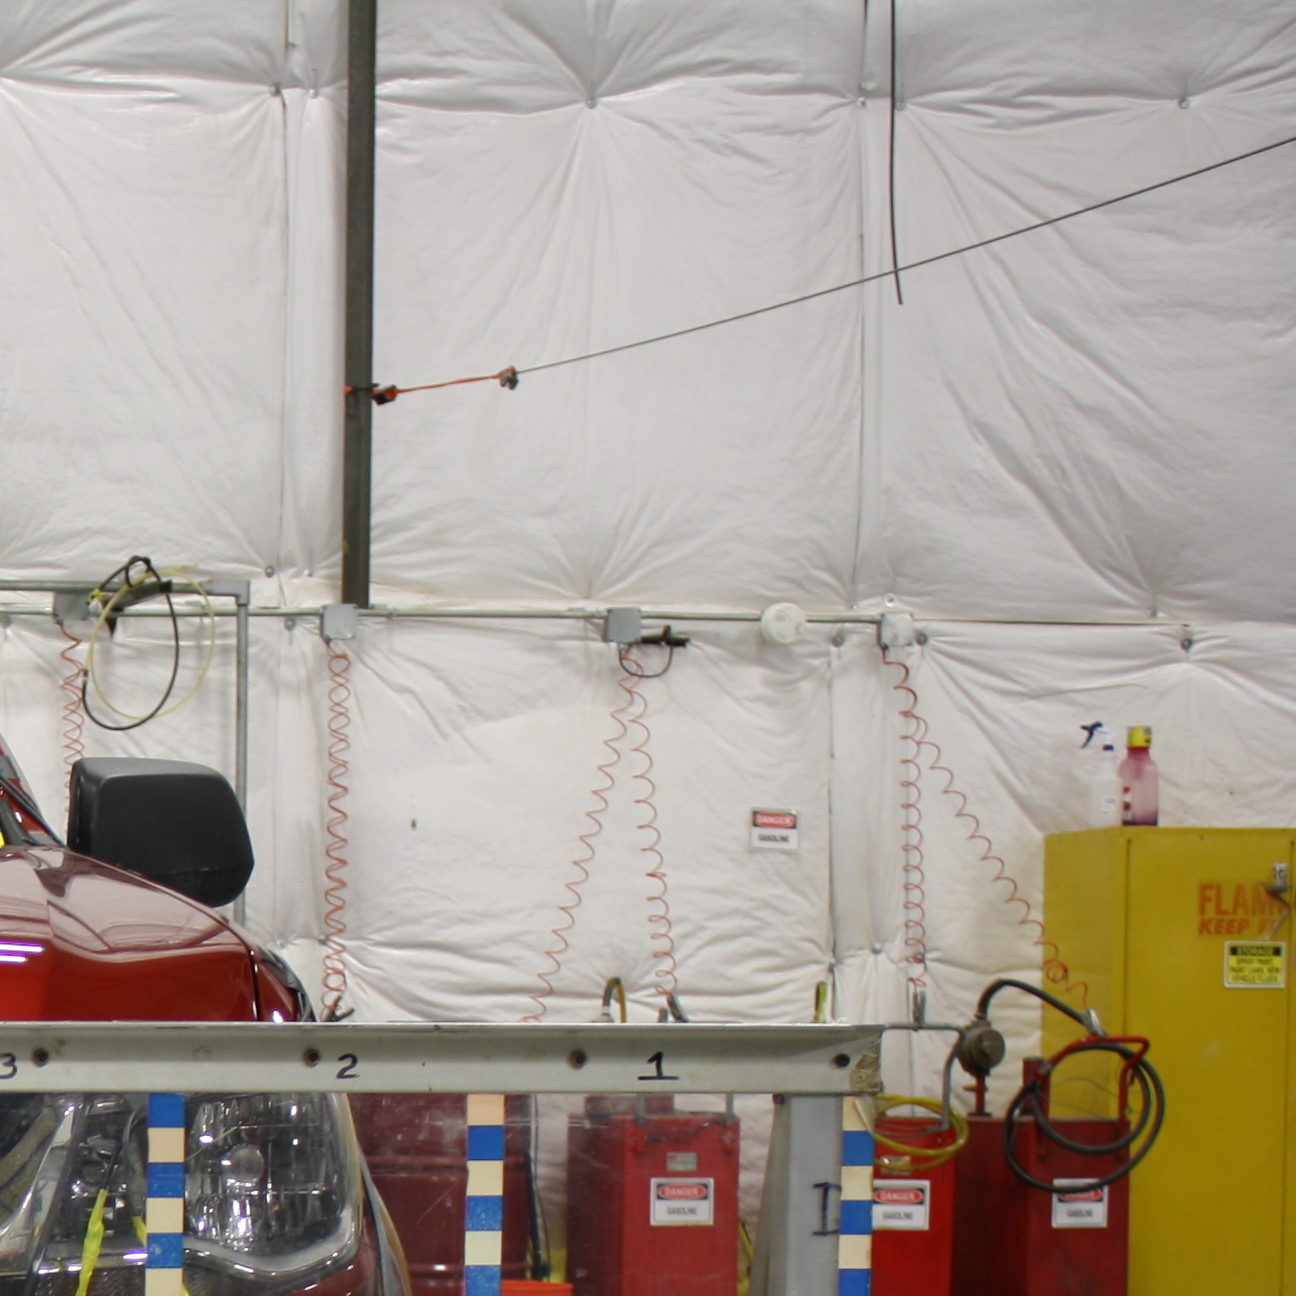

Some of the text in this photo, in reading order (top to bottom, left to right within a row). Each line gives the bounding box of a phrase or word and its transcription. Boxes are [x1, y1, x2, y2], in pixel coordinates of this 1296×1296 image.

[1198, 918, 1250, 935] KEEP
[336, 1053, 360, 1080] 2
[638, 1051, 678, 1081] 1
